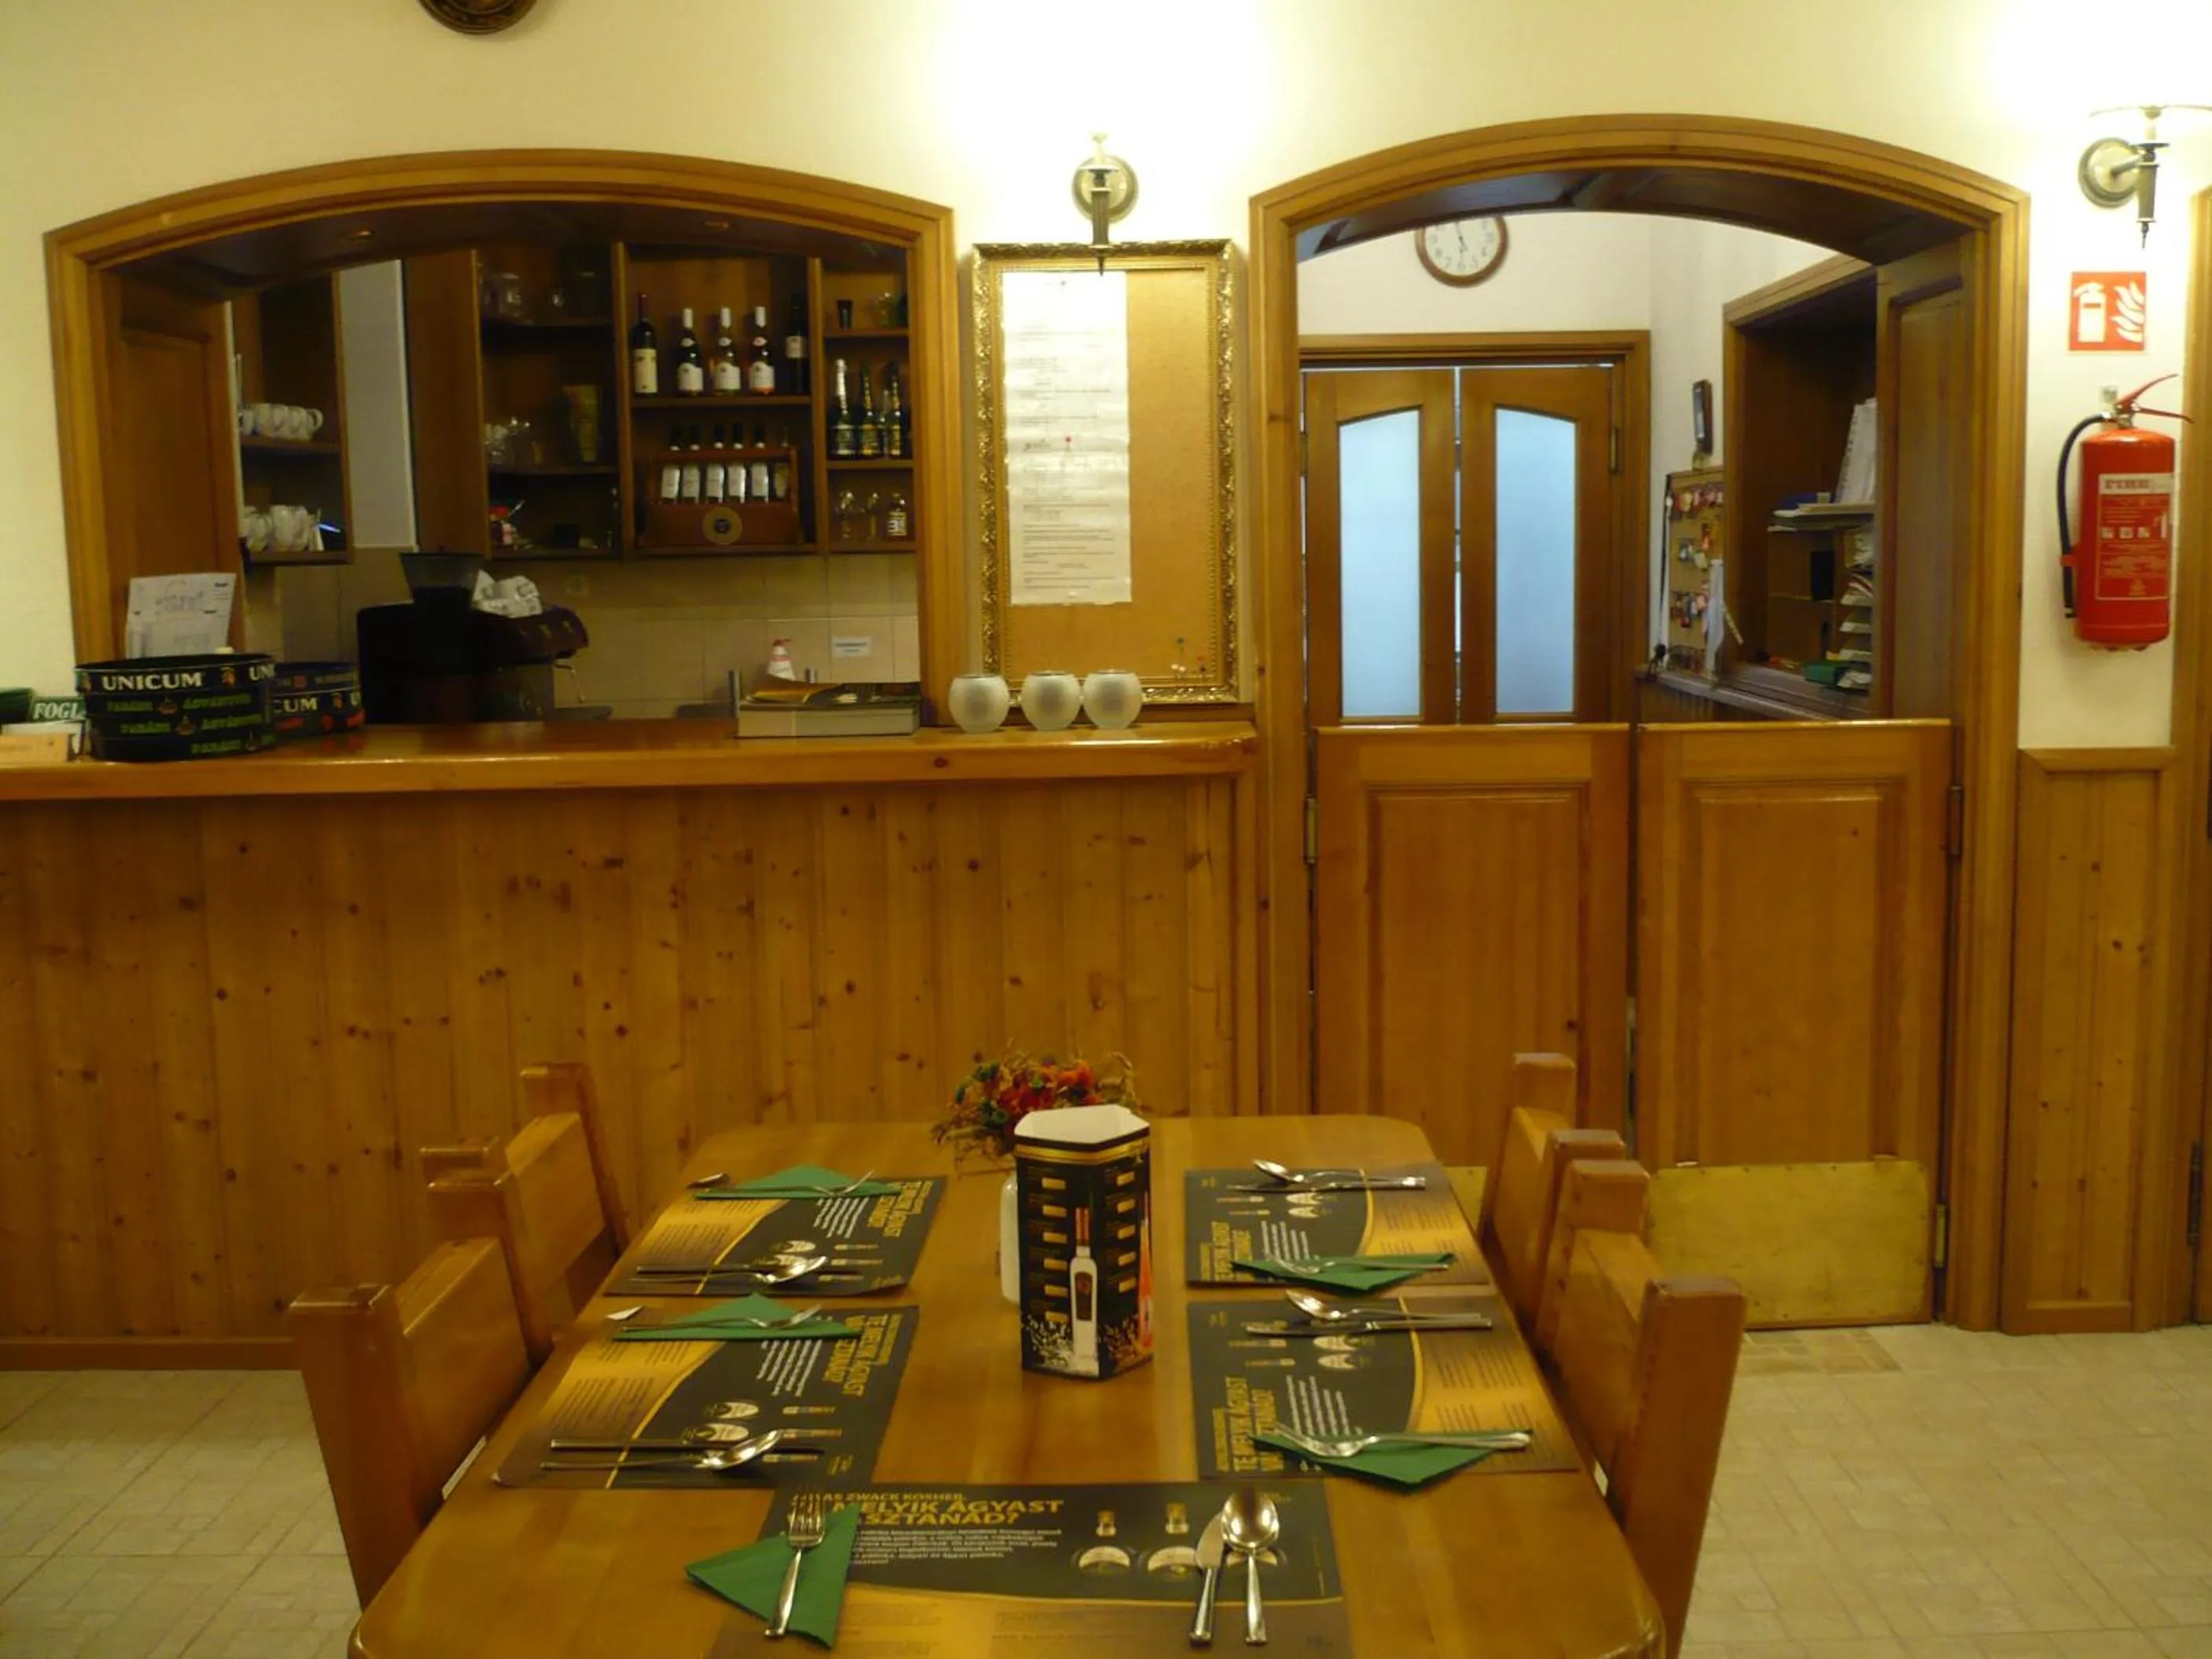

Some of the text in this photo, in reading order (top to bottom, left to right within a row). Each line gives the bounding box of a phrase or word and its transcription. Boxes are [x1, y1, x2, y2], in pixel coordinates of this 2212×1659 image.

[102, 672, 203, 691] UNICUM
[33, 701, 86, 720] FOGL
[273, 696, 318, 714] CUM
